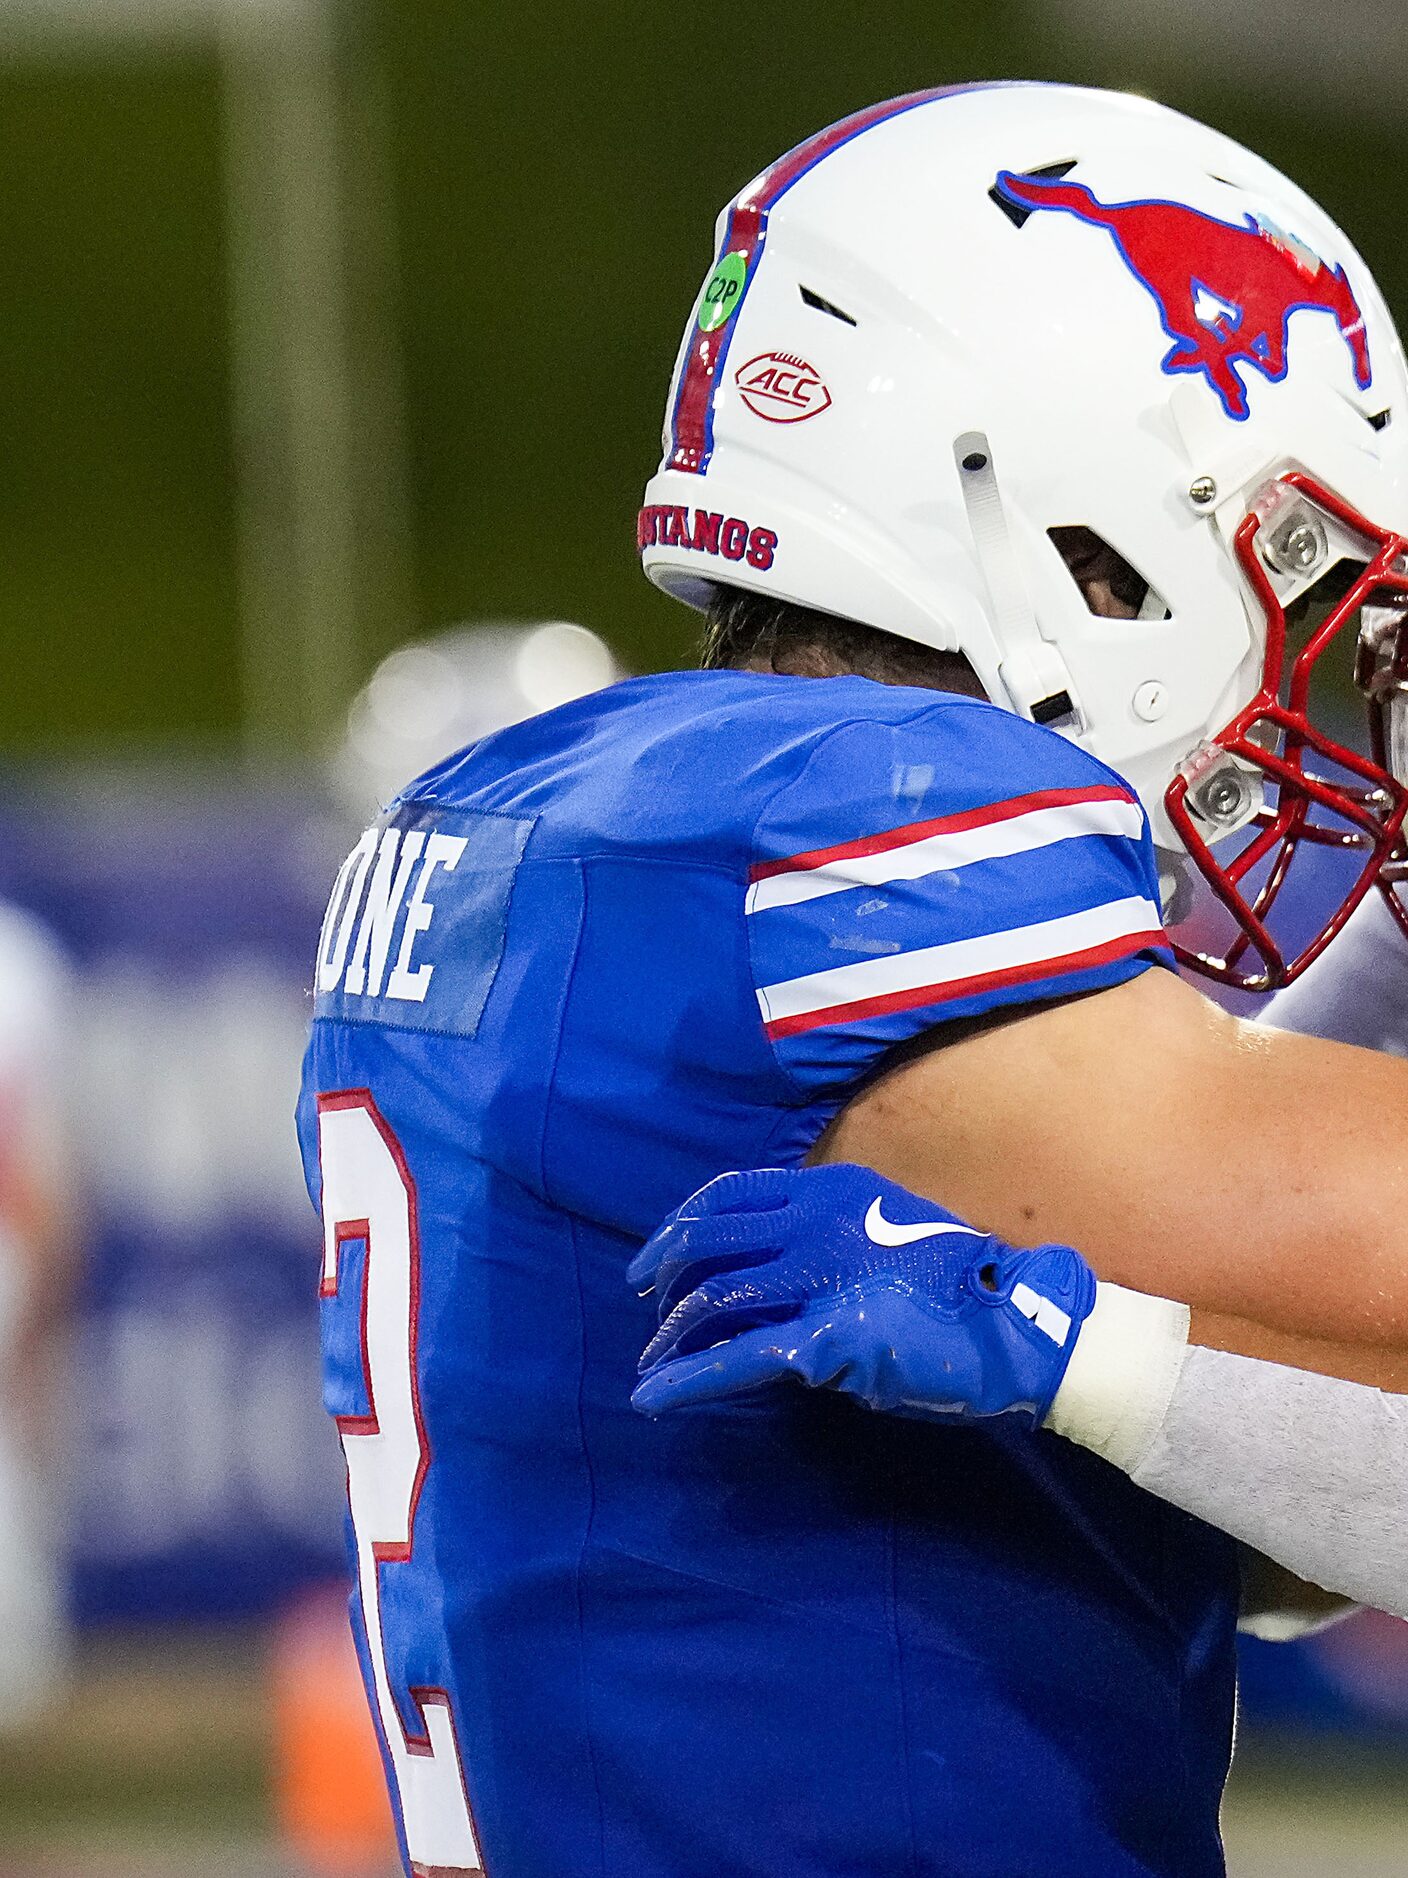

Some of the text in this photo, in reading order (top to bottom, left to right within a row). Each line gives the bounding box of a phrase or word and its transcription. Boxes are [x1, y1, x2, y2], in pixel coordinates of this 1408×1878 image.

[705, 277, 738, 304] C2P
[746, 368, 822, 402] ACC
[317, 1090, 486, 1878] 2
